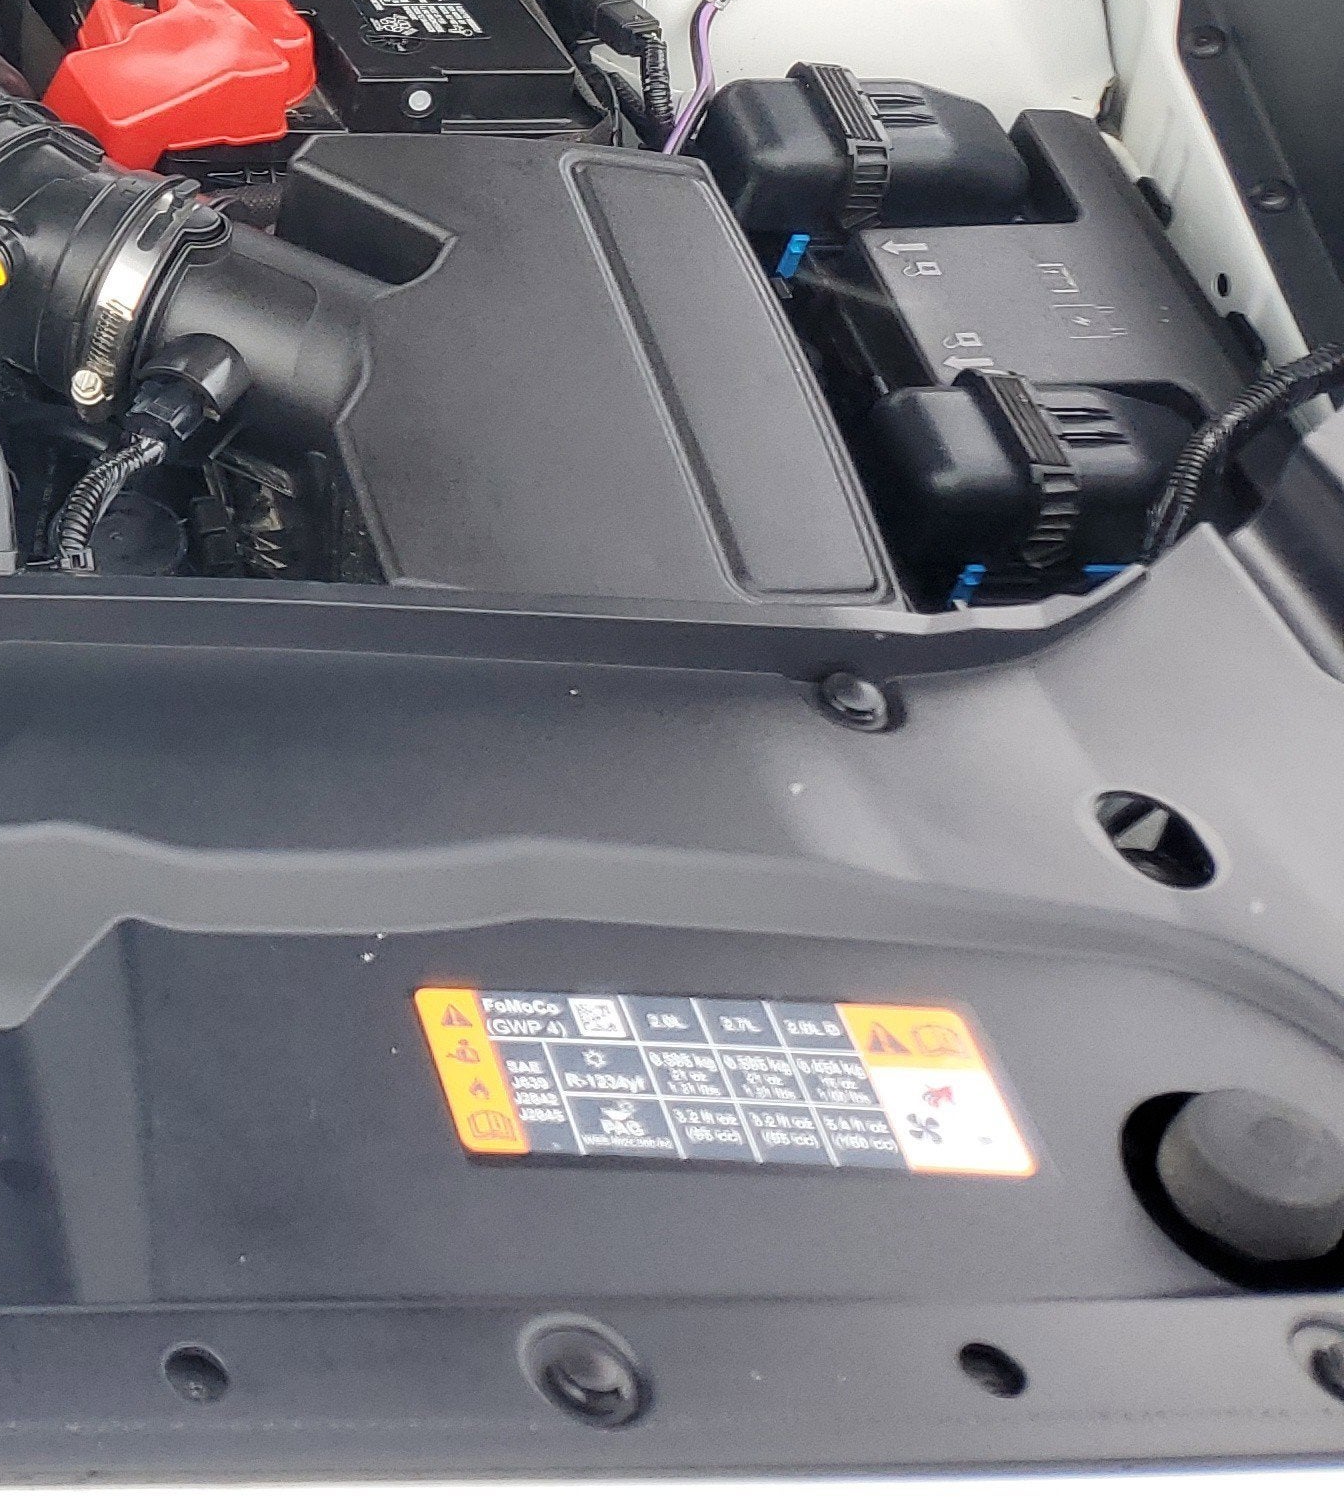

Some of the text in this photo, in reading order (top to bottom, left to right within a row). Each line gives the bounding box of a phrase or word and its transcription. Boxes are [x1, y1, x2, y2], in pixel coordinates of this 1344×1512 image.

[482, 997, 561, 1015] FoMoCo
[486, 1018, 542, 1036] (GWP
[564, 1071, 647, 1094] R-1234yf
